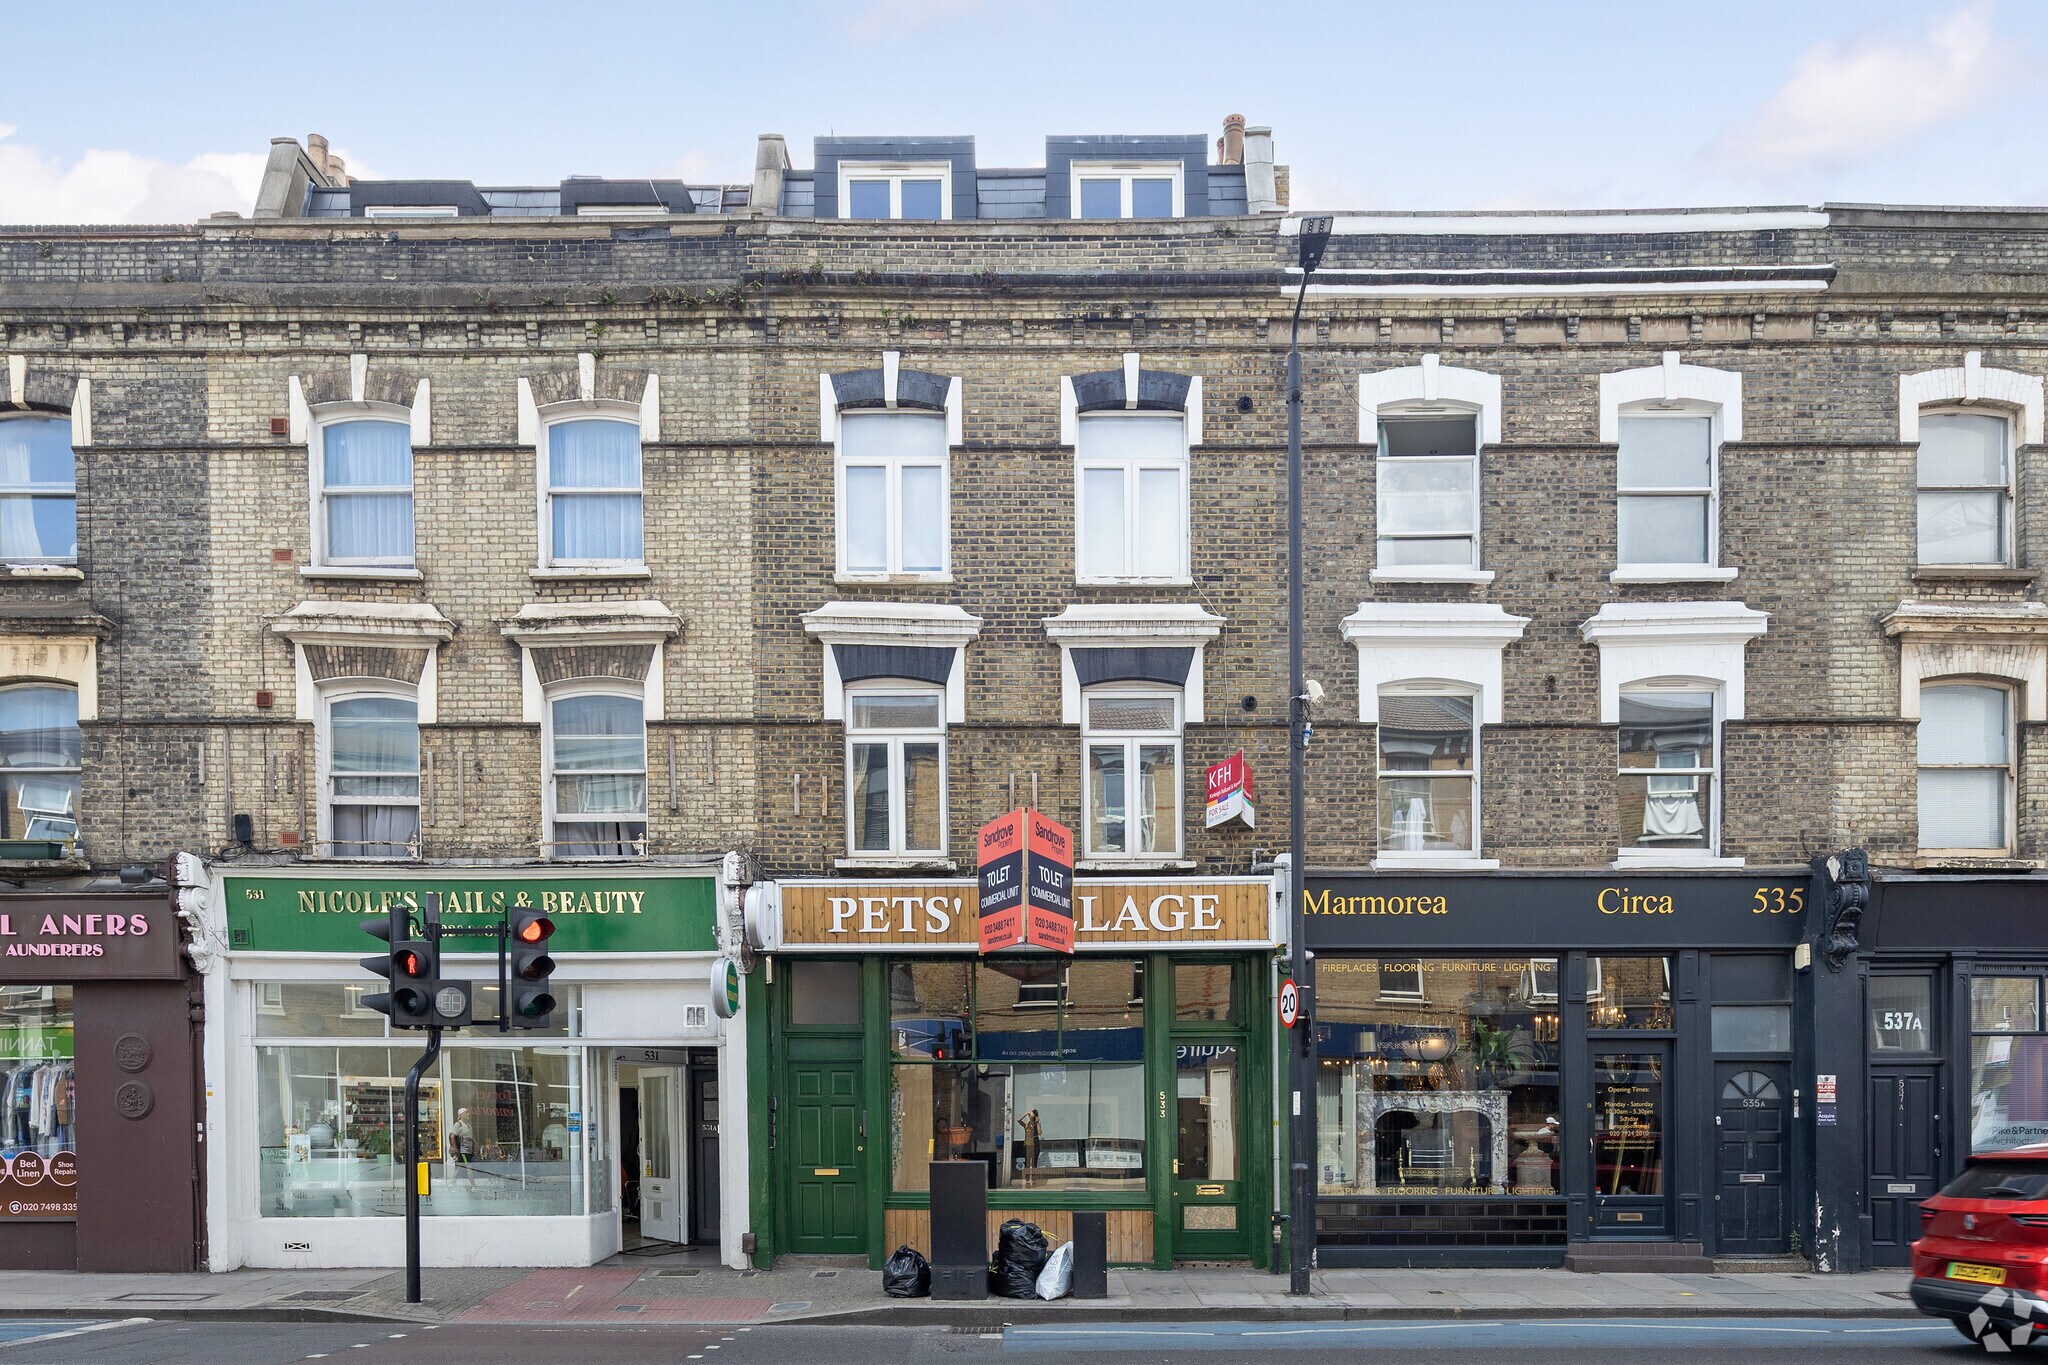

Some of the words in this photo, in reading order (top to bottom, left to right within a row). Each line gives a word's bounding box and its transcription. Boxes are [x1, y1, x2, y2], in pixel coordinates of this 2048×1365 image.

[1209, 764, 1231, 790] KFH
[984, 823, 1014, 848] Sandrove
[997, 837, 1013, 851] Property
[1035, 821, 1066, 849] Sandrove
[1051, 843, 1065, 859] Property
[987, 873, 996, 888] TO
[996, 865, 1011, 884] LET
[1039, 865, 1050, 884] TO
[1050, 870, 1064, 889] LET
[246, 889, 265, 900] 531
[298, 890, 419, 914] NICOLE'S
[514, 891, 535, 909] &
[541, 891, 645, 914] BEAUTY
[980, 890, 1007, 909] COMMERCIAL
[1007, 885, 1019, 900] UNIT
[1031, 885, 1062, 906] COMMERCIAL
[1062, 897, 1071, 909] UNIT
[1303, 889, 1448, 915] Marmorea
[1597, 887, 1674, 914] Circa
[1752, 887, 1804, 914] 535
[827, 896, 963, 934] PETS'
[1074, 894, 1222, 933] LAGE
[1322, 963, 1377, 972] FIREPLACES
[1384, 963, 1434, 972] FLOORING
[1441, 963, 1496, 972] FURNITURE
[1282, 993, 1295, 1014] 20
[1884, 1012, 1922, 1030] 537A
[644, 1051, 659, 1061] 531
[1743, 1099, 1765, 1107] 535A
[17, 1169, 40, 1177] Linen
[20, 1160, 36, 1168] Bed
[1388, 1187, 1438, 1195] FLOORING
[1446, 1187, 1497, 1195] FURNITUR
[1506, 1187, 1553, 1195] LIGHTING
[23, 1203, 39, 1211] 020
[40, 1203, 61, 1211] 7498
